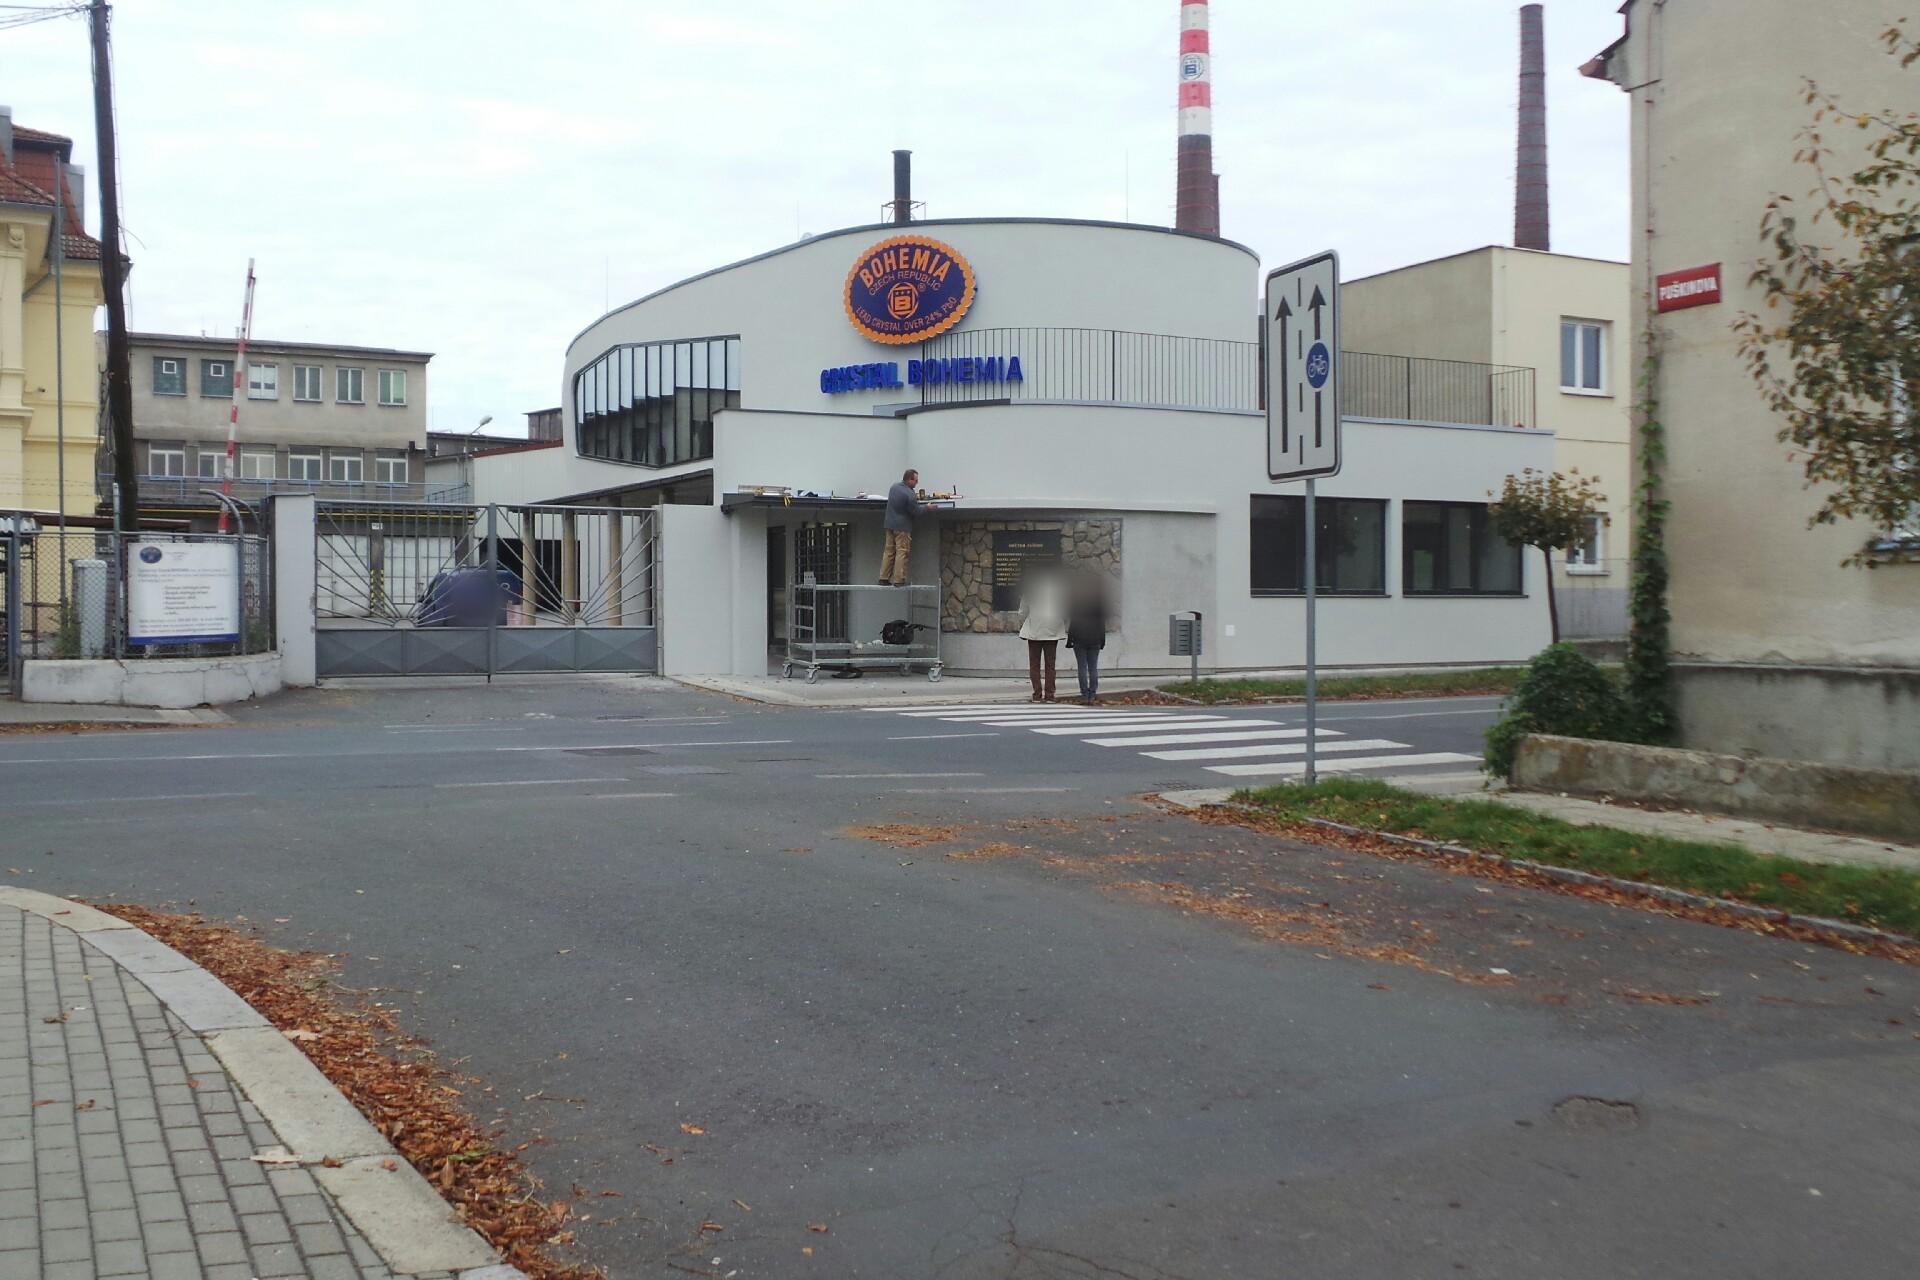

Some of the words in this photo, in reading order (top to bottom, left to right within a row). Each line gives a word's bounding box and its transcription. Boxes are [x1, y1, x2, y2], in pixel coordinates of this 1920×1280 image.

[859, 248, 951, 288] BOHEMIA
[869, 274, 895, 296] CZECH
[898, 270, 941, 291] REPUBLIC
[856, 306, 872, 323] LEAD
[872, 318, 900, 331] CRYSTAL
[904, 318, 924, 330] OVER
[820, 362, 904, 393] CRYSTAL
[908, 356, 1024, 385] BOHEMIA
